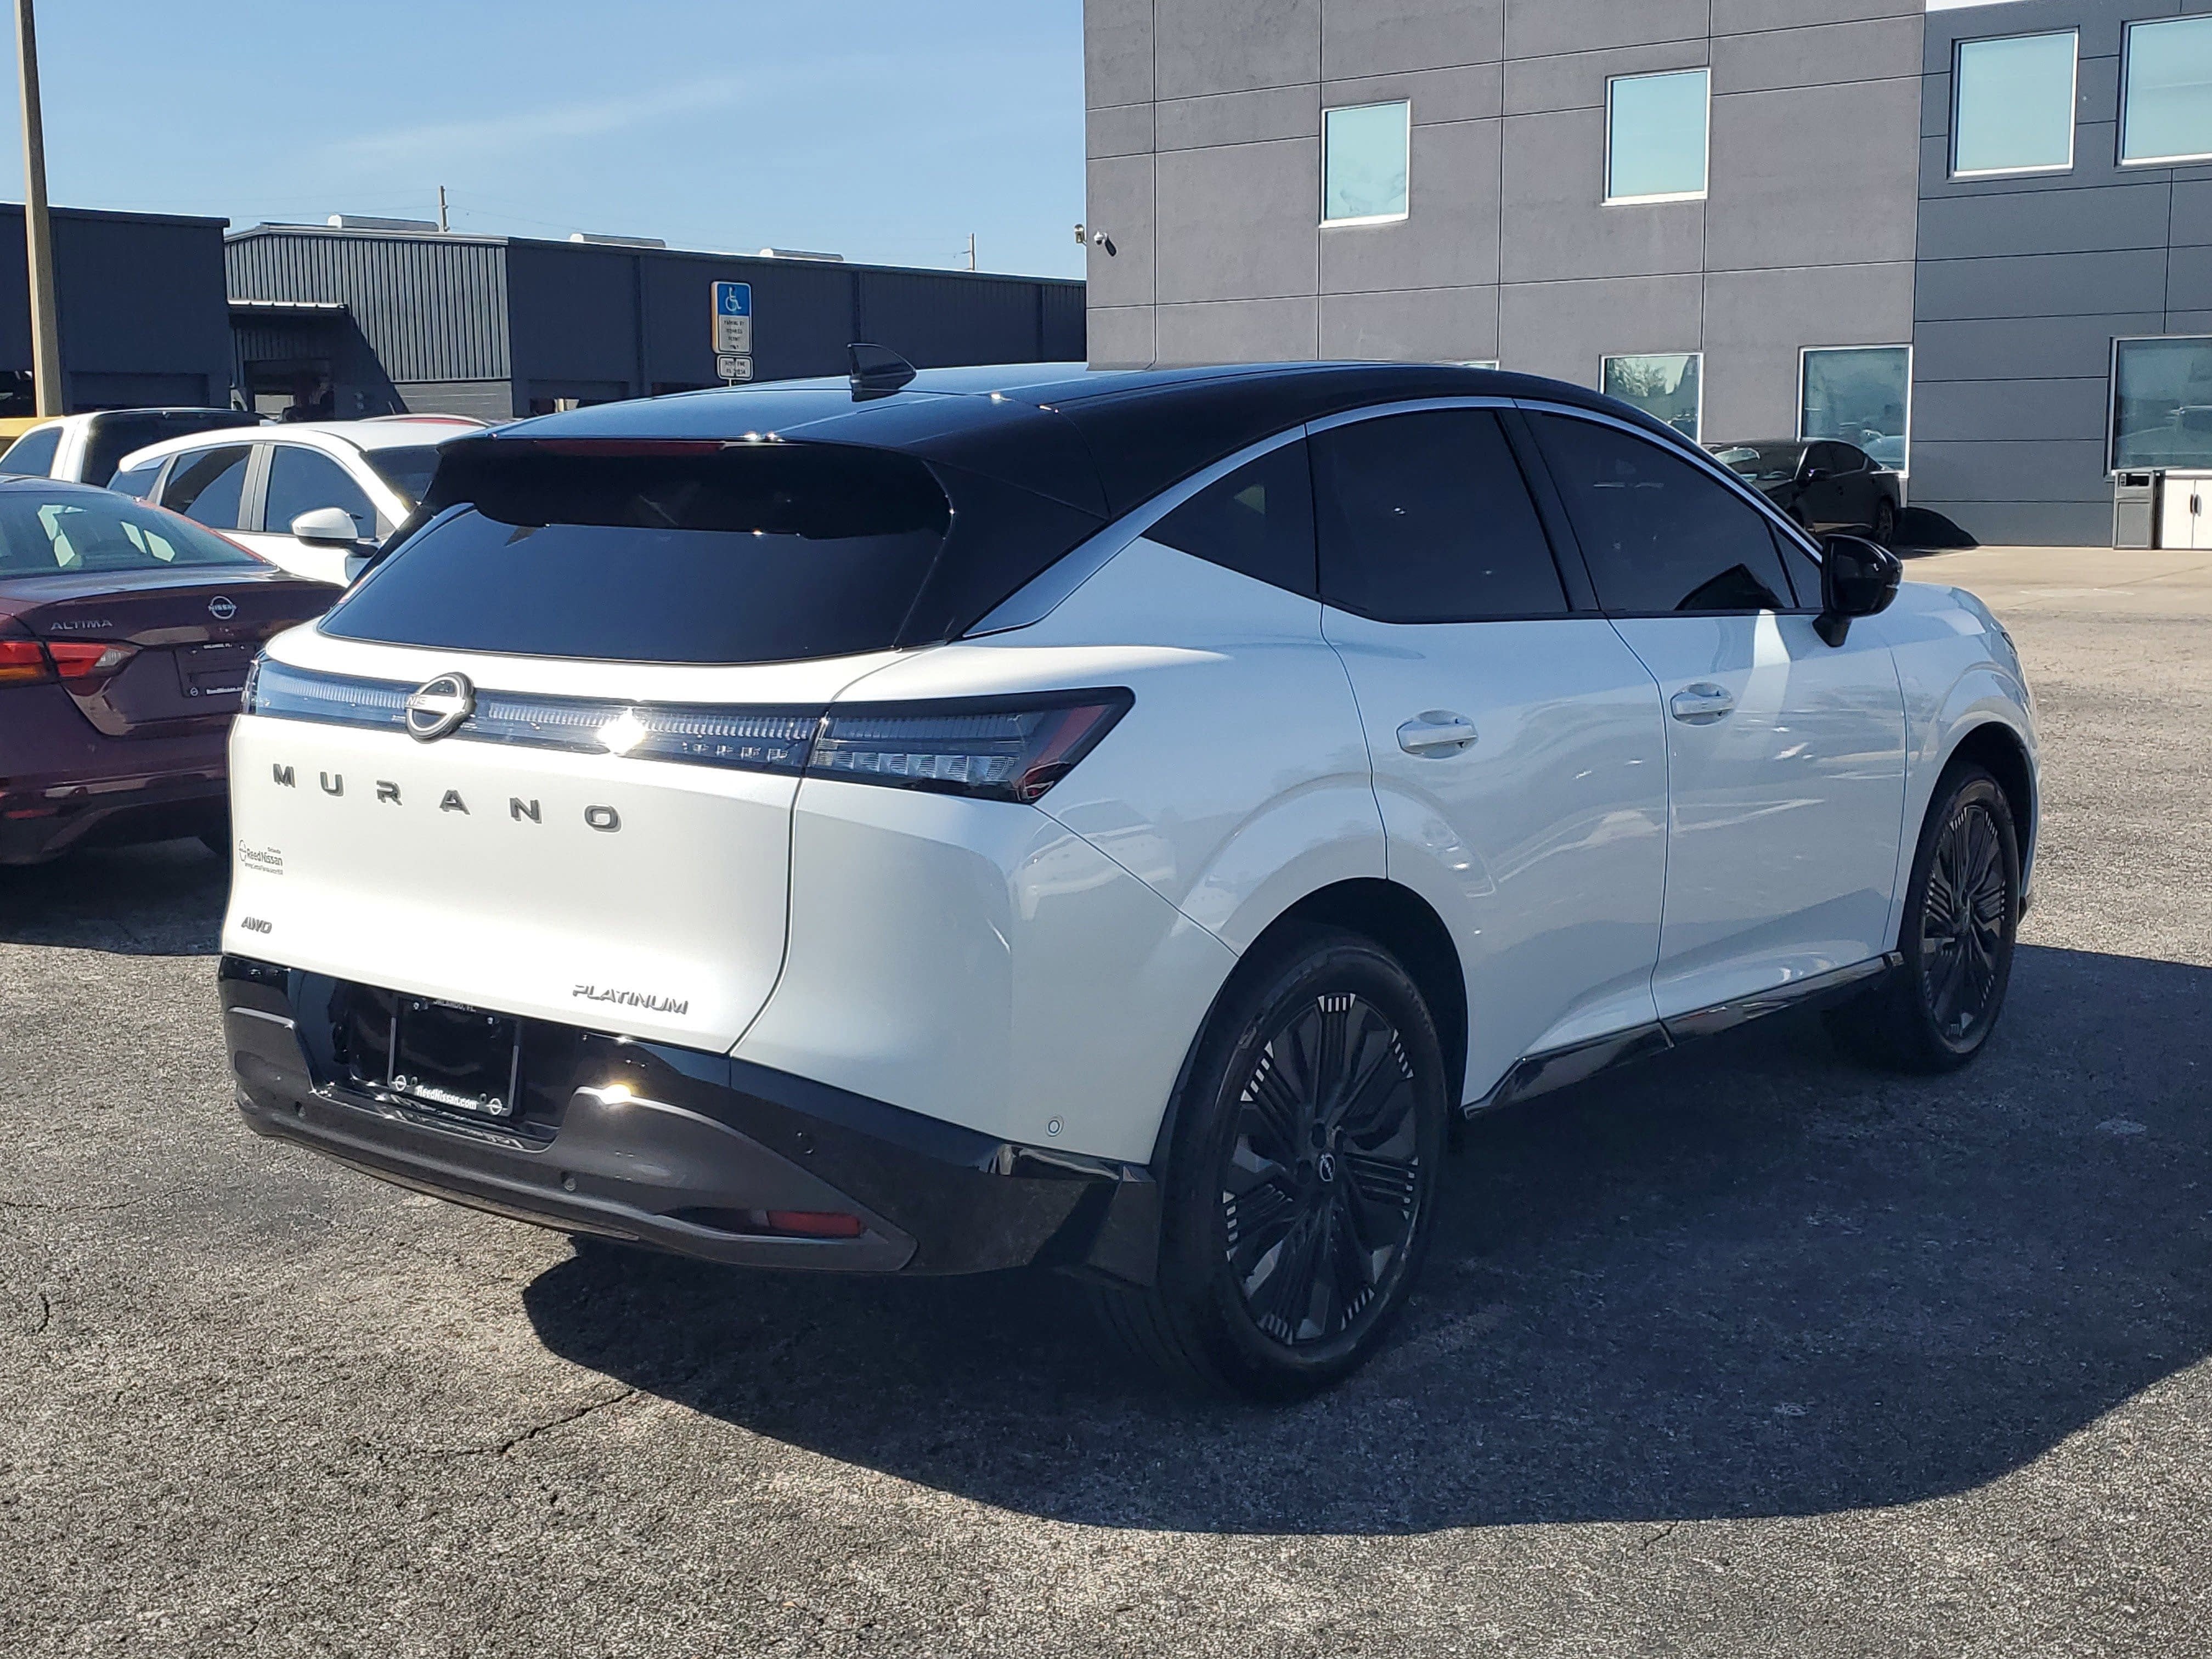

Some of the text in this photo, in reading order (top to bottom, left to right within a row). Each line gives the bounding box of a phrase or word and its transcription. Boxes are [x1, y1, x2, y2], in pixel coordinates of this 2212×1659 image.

[51, 620, 112, 630] ALTIMA
[273, 763, 621, 832] MURANO
[241, 917, 272, 934] AWD
[572, 984, 689, 1015] PLATINUM
[415, 1085, 477, 1110] ReedNissan.com
